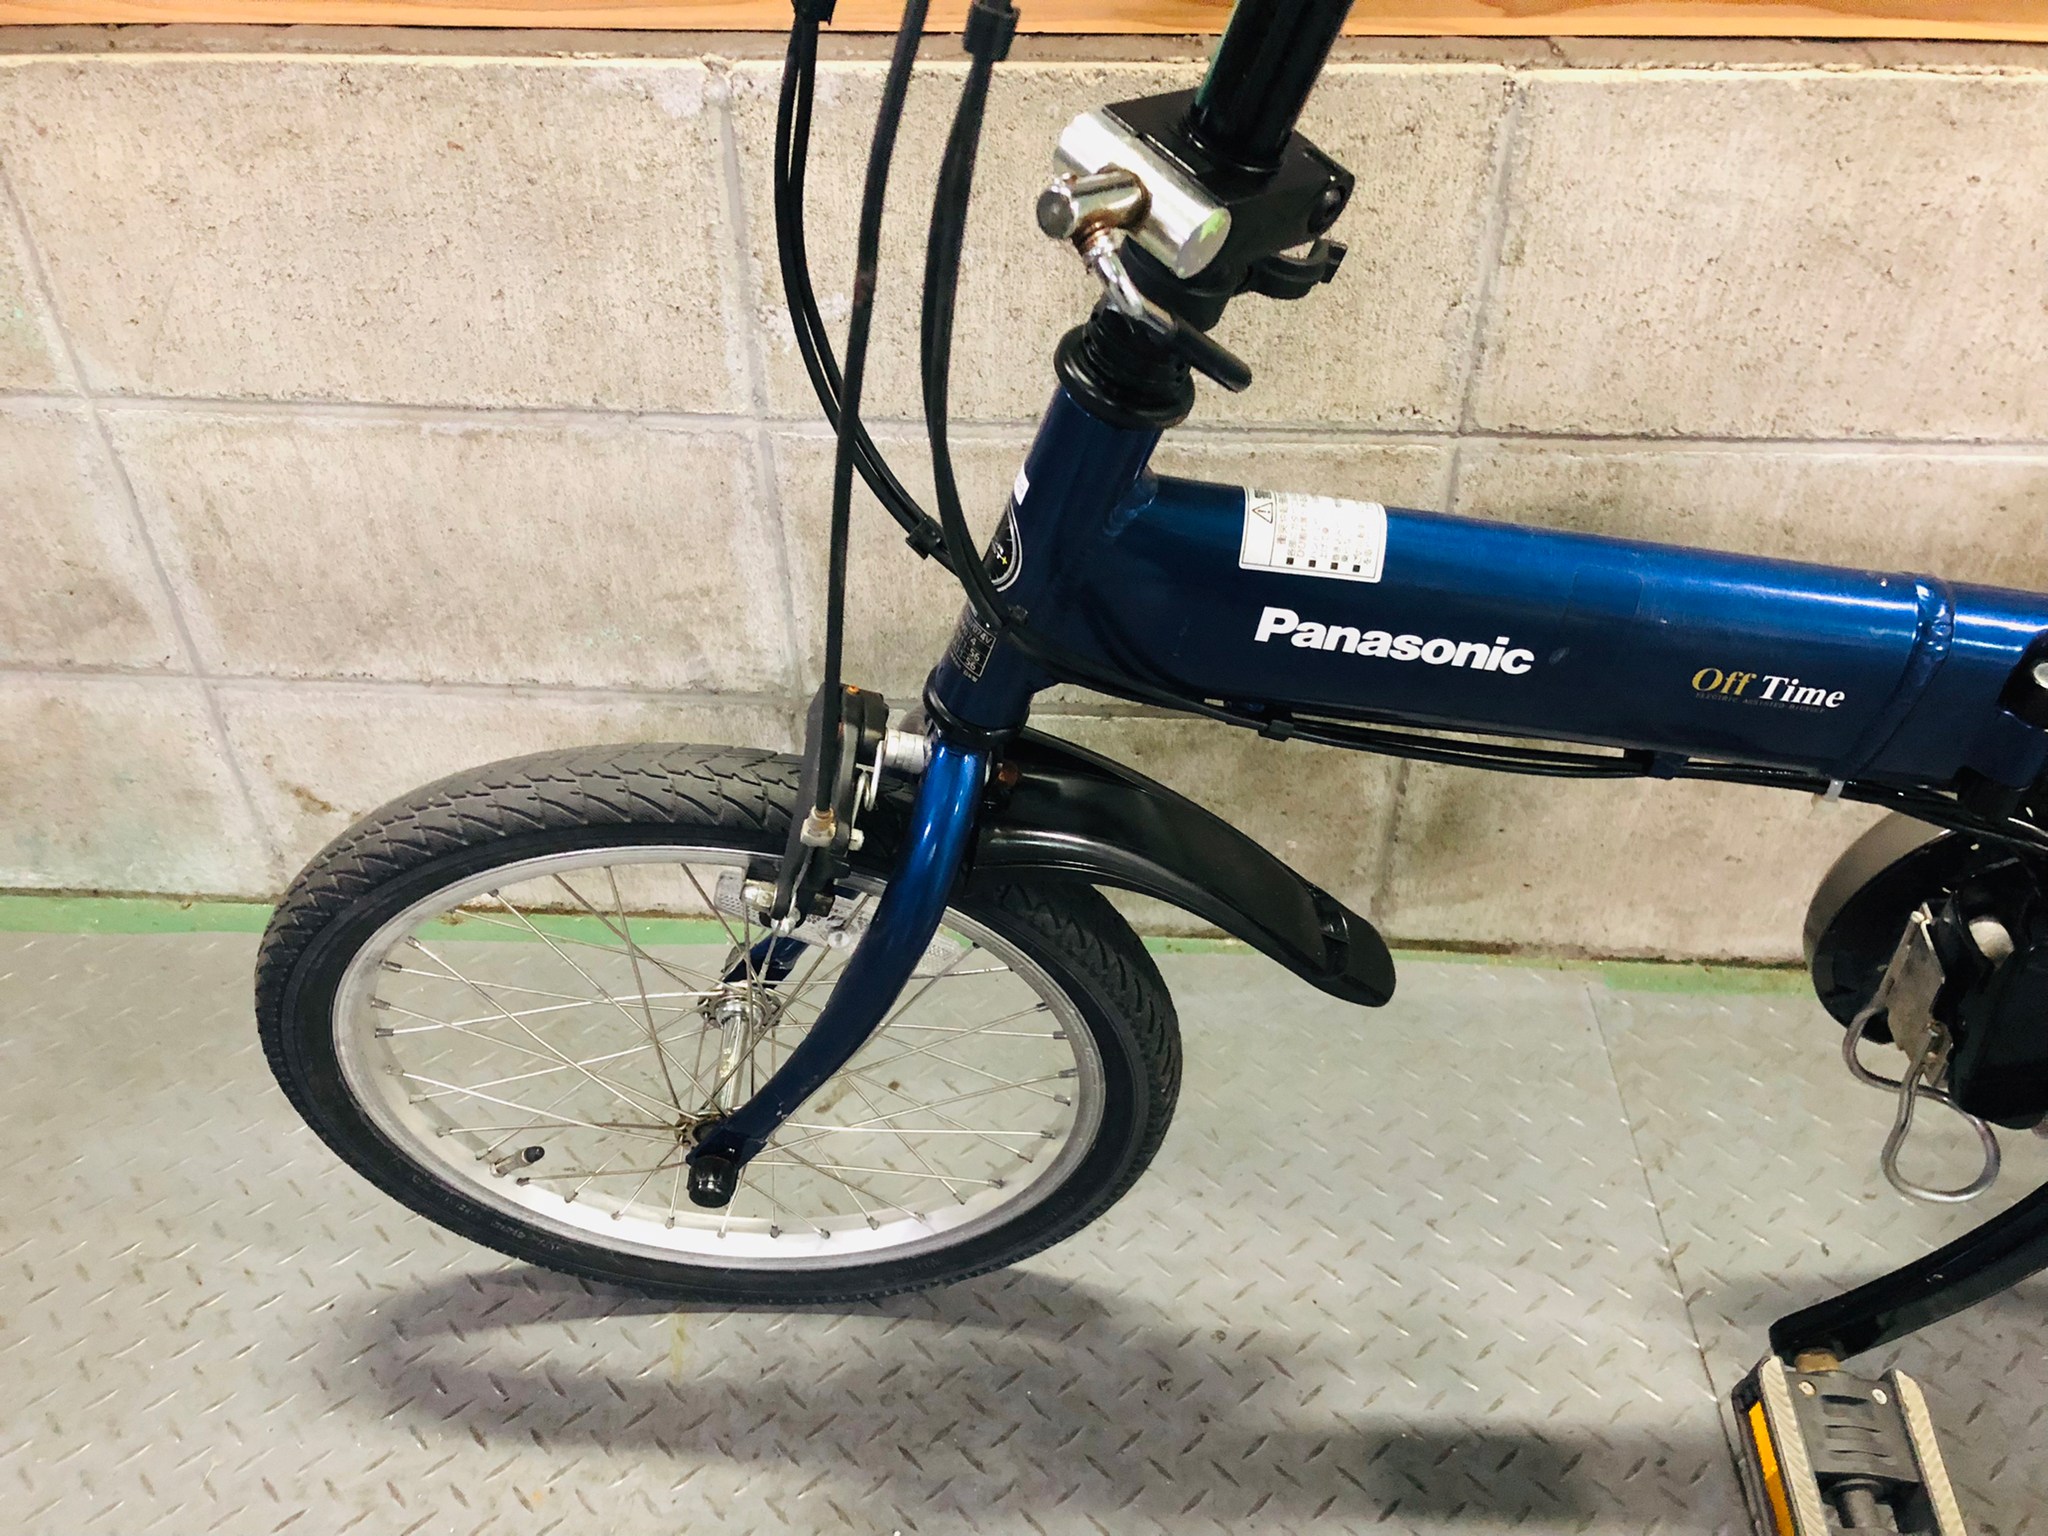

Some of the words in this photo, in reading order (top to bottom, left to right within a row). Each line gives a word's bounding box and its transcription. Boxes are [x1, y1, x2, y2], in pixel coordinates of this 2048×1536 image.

[1254, 606, 1535, 675] Panasonic
[1691, 667, 1757, 696] Off
[1758, 675, 1846, 709] Time
